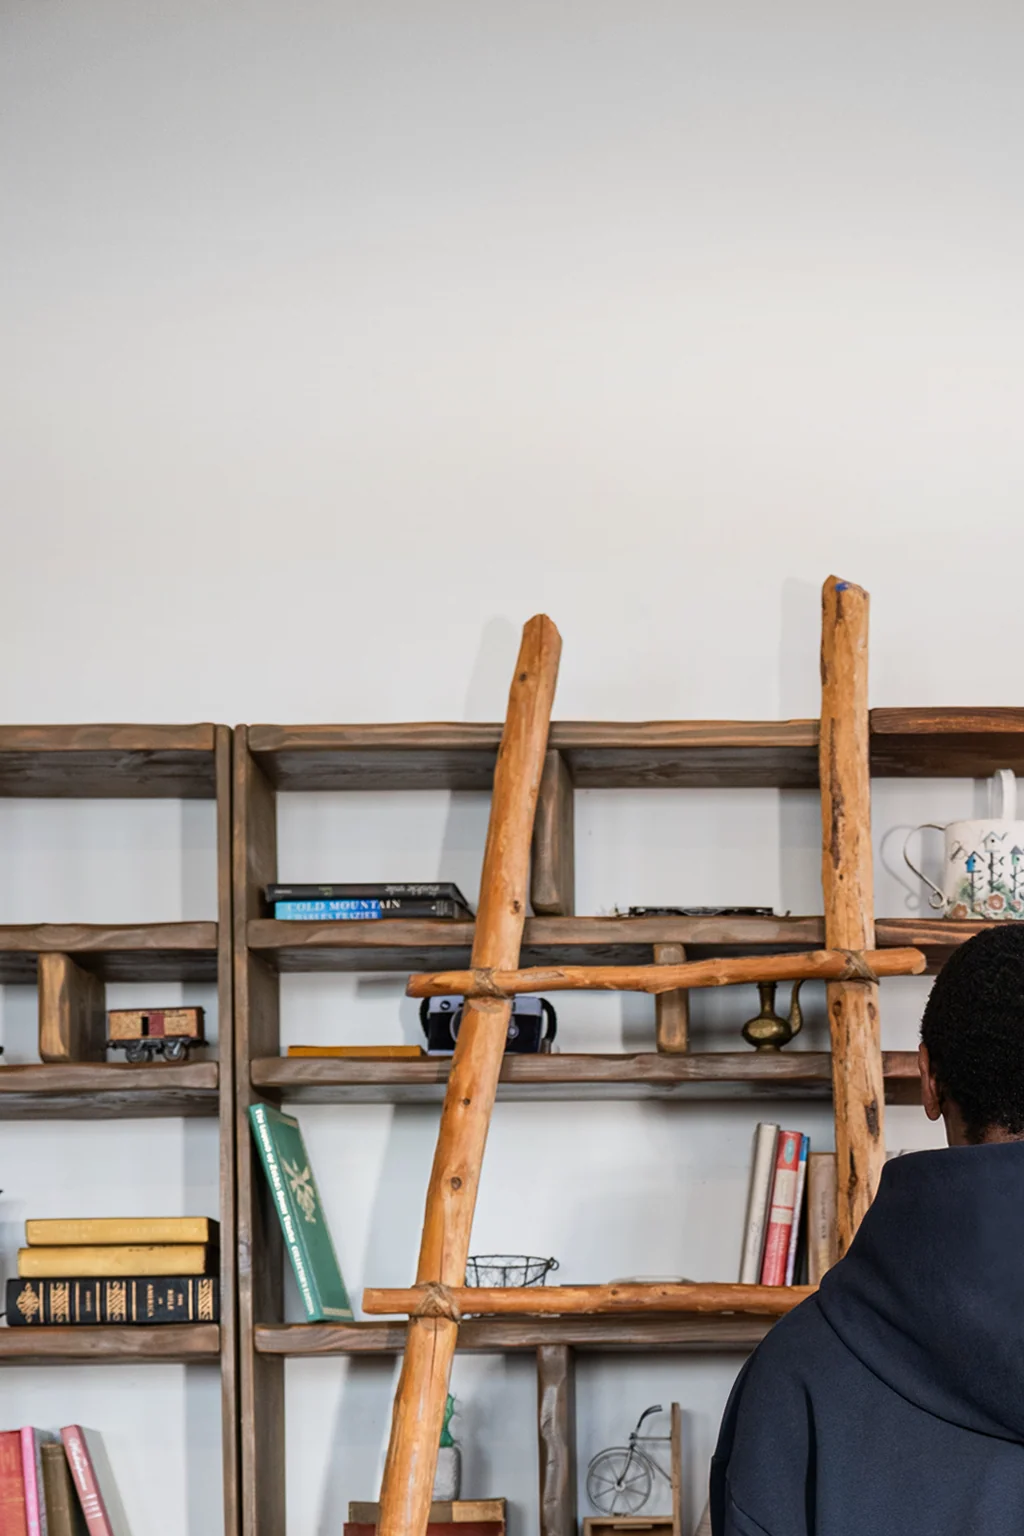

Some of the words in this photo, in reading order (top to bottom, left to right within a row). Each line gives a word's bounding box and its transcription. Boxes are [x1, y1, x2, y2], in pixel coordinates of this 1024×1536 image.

[286, 901, 328, 912] COLD
[329, 899, 402, 912] MOUNTAIN
[334, 911, 379, 920] FRAZIER
